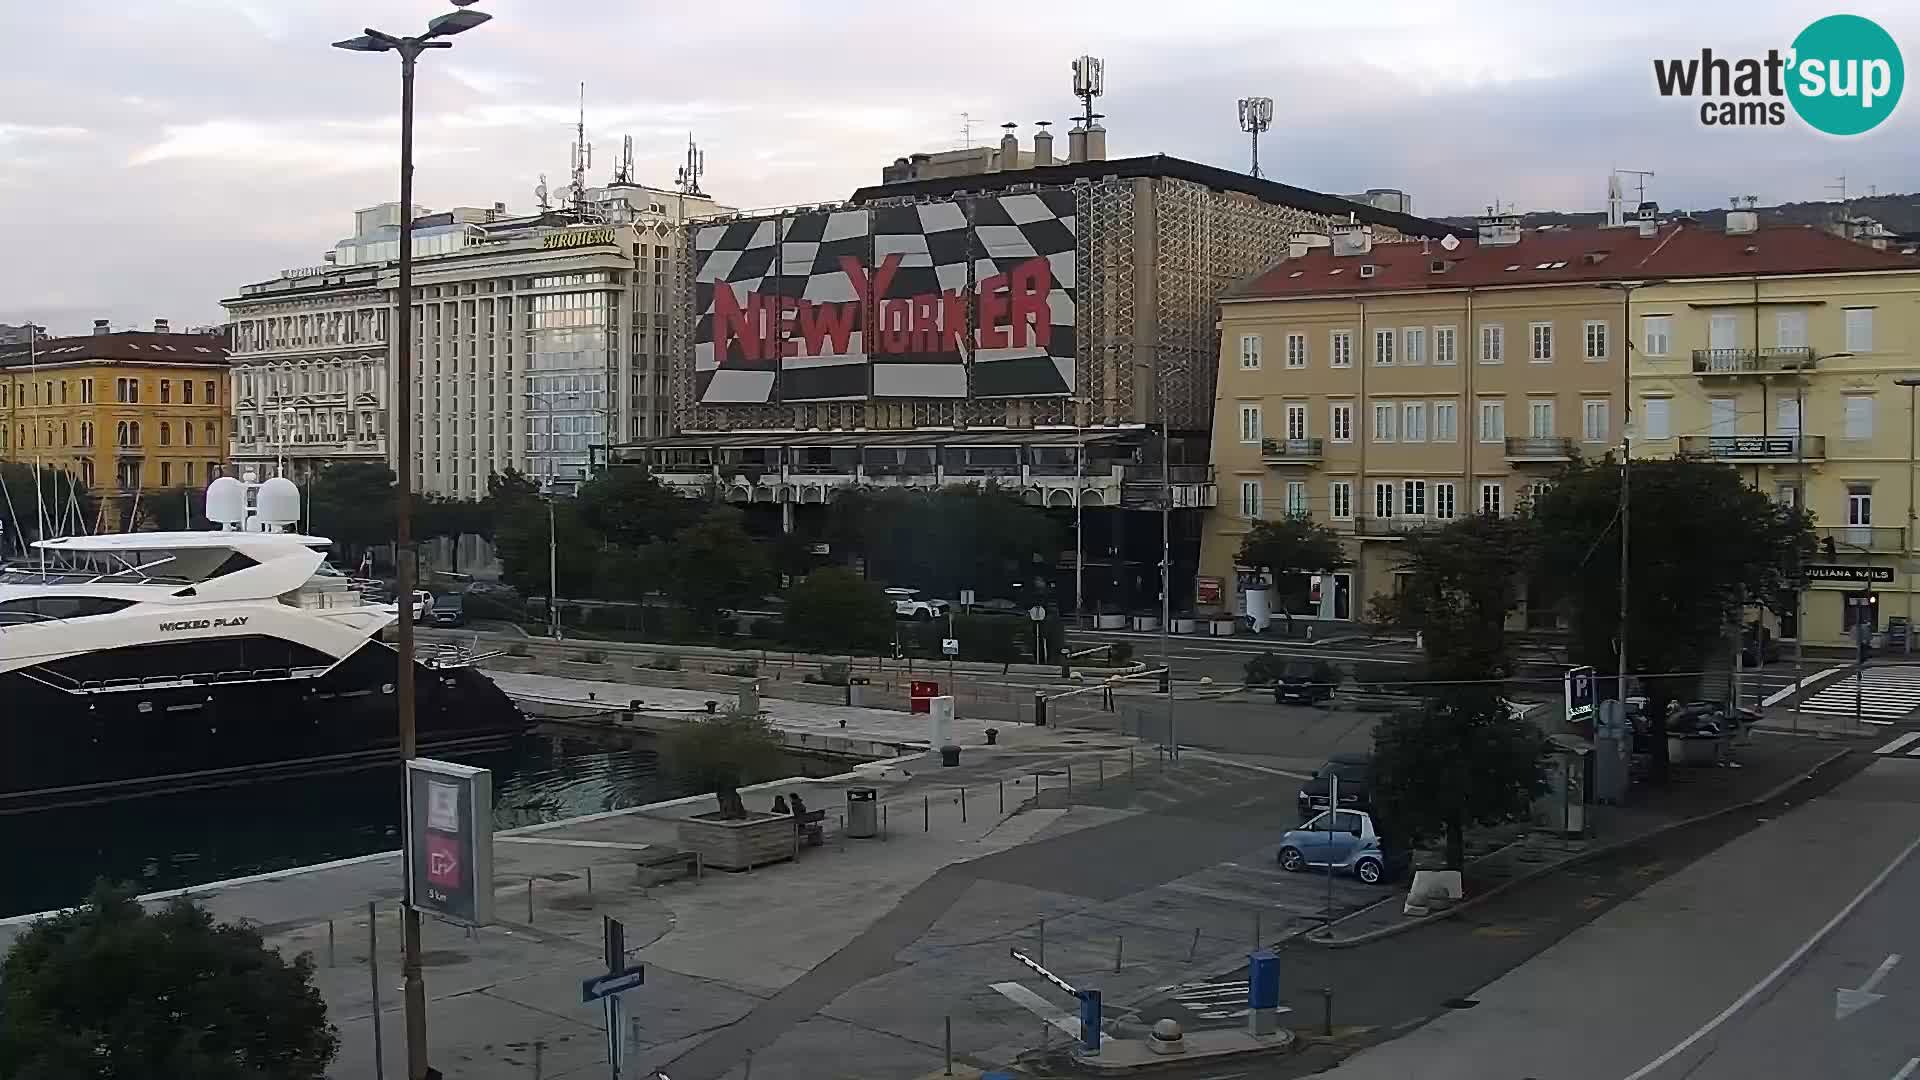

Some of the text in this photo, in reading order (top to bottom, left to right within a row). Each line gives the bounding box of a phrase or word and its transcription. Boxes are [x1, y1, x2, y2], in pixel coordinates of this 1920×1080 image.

[1805, 569, 1889, 579] JULIANA NAILS
[159, 616, 249, 632] WICKED PLAY
